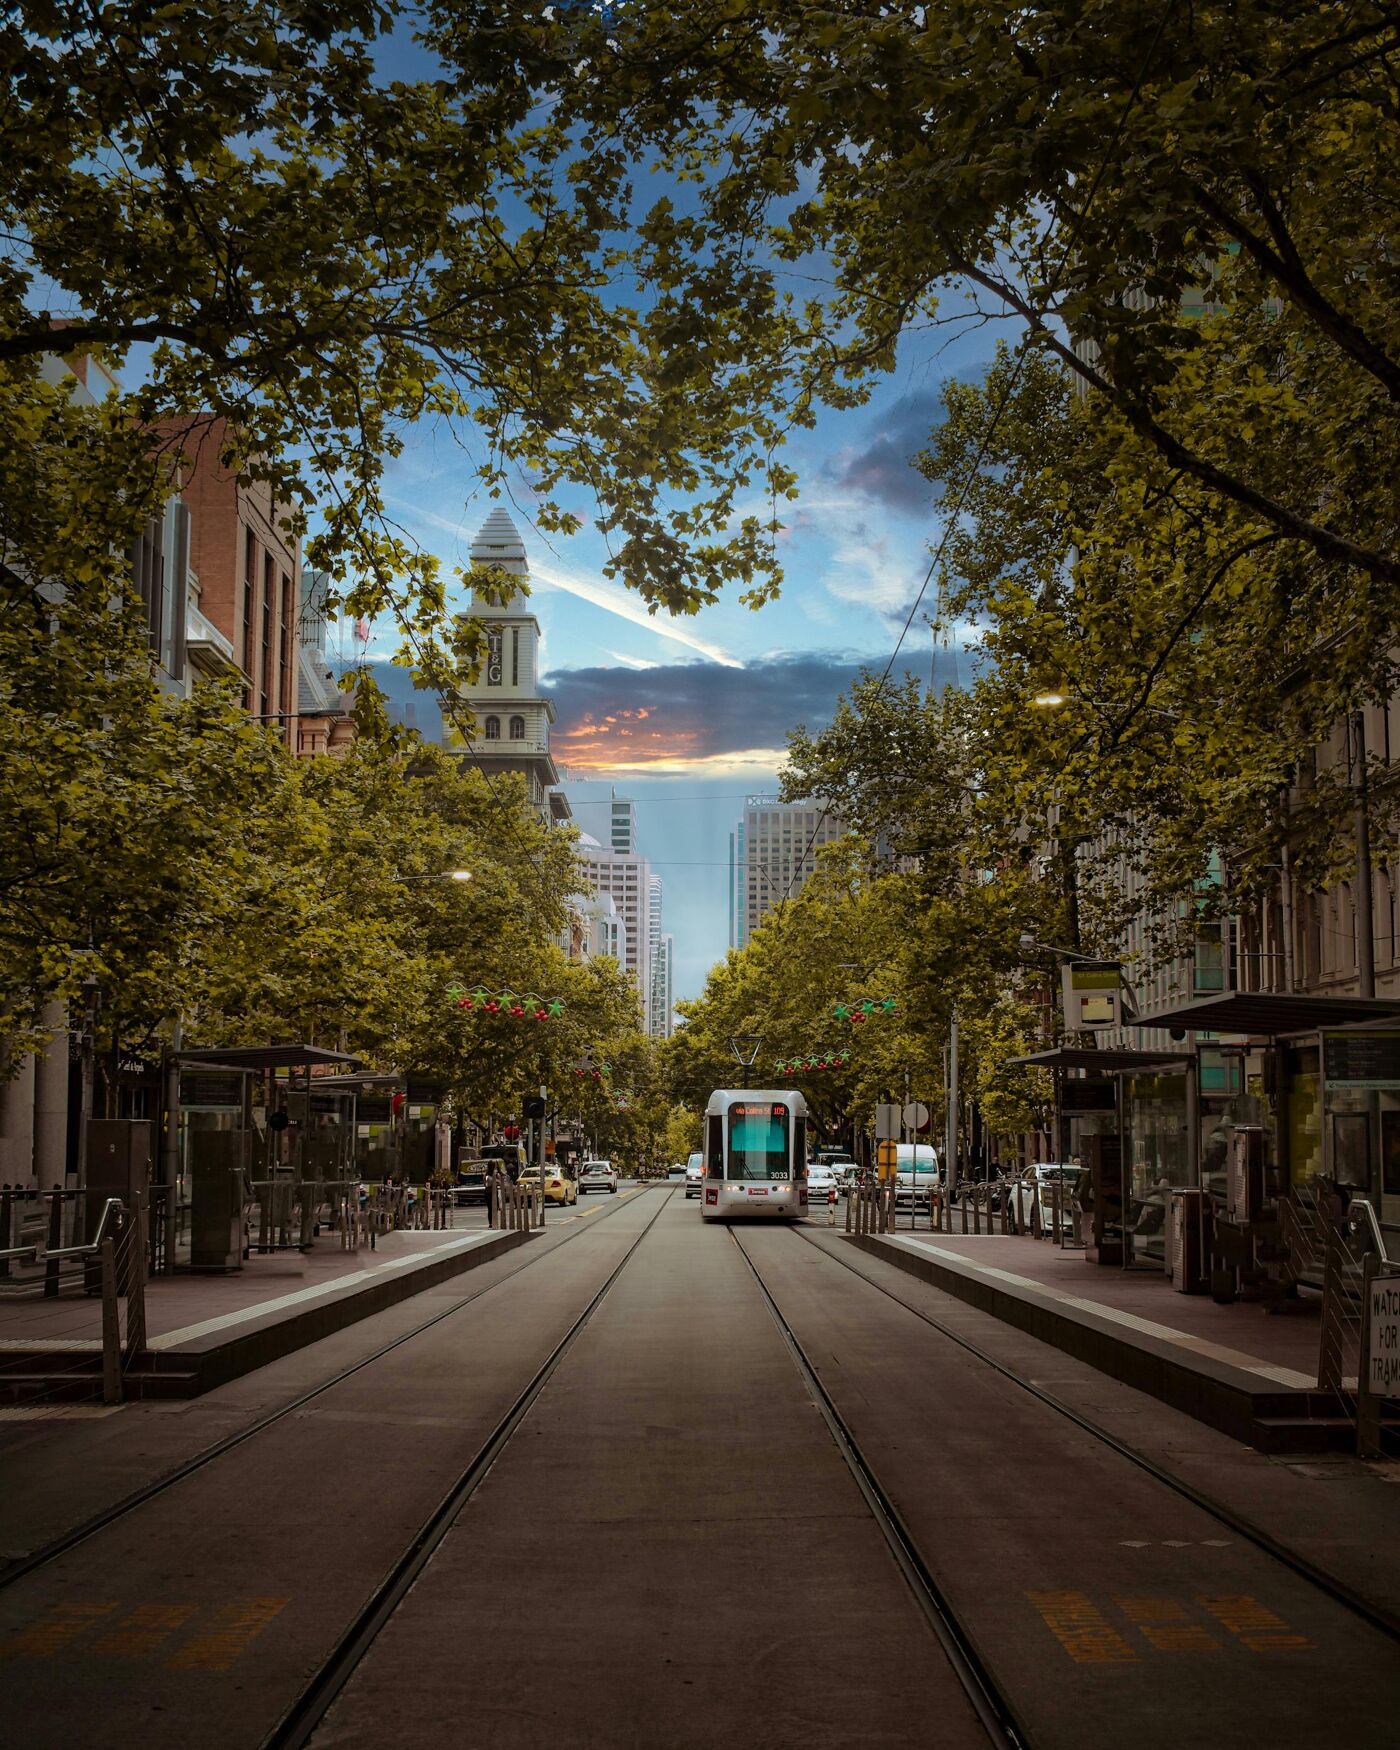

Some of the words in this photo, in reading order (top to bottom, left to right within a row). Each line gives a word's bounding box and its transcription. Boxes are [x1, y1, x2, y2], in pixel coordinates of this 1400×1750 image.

[774, 1106, 785, 1115] 109
[771, 1171, 788, 1179] 3033
[1373, 1291, 1400, 1316] WATC
[1379, 1325, 1397, 1348] FOR
